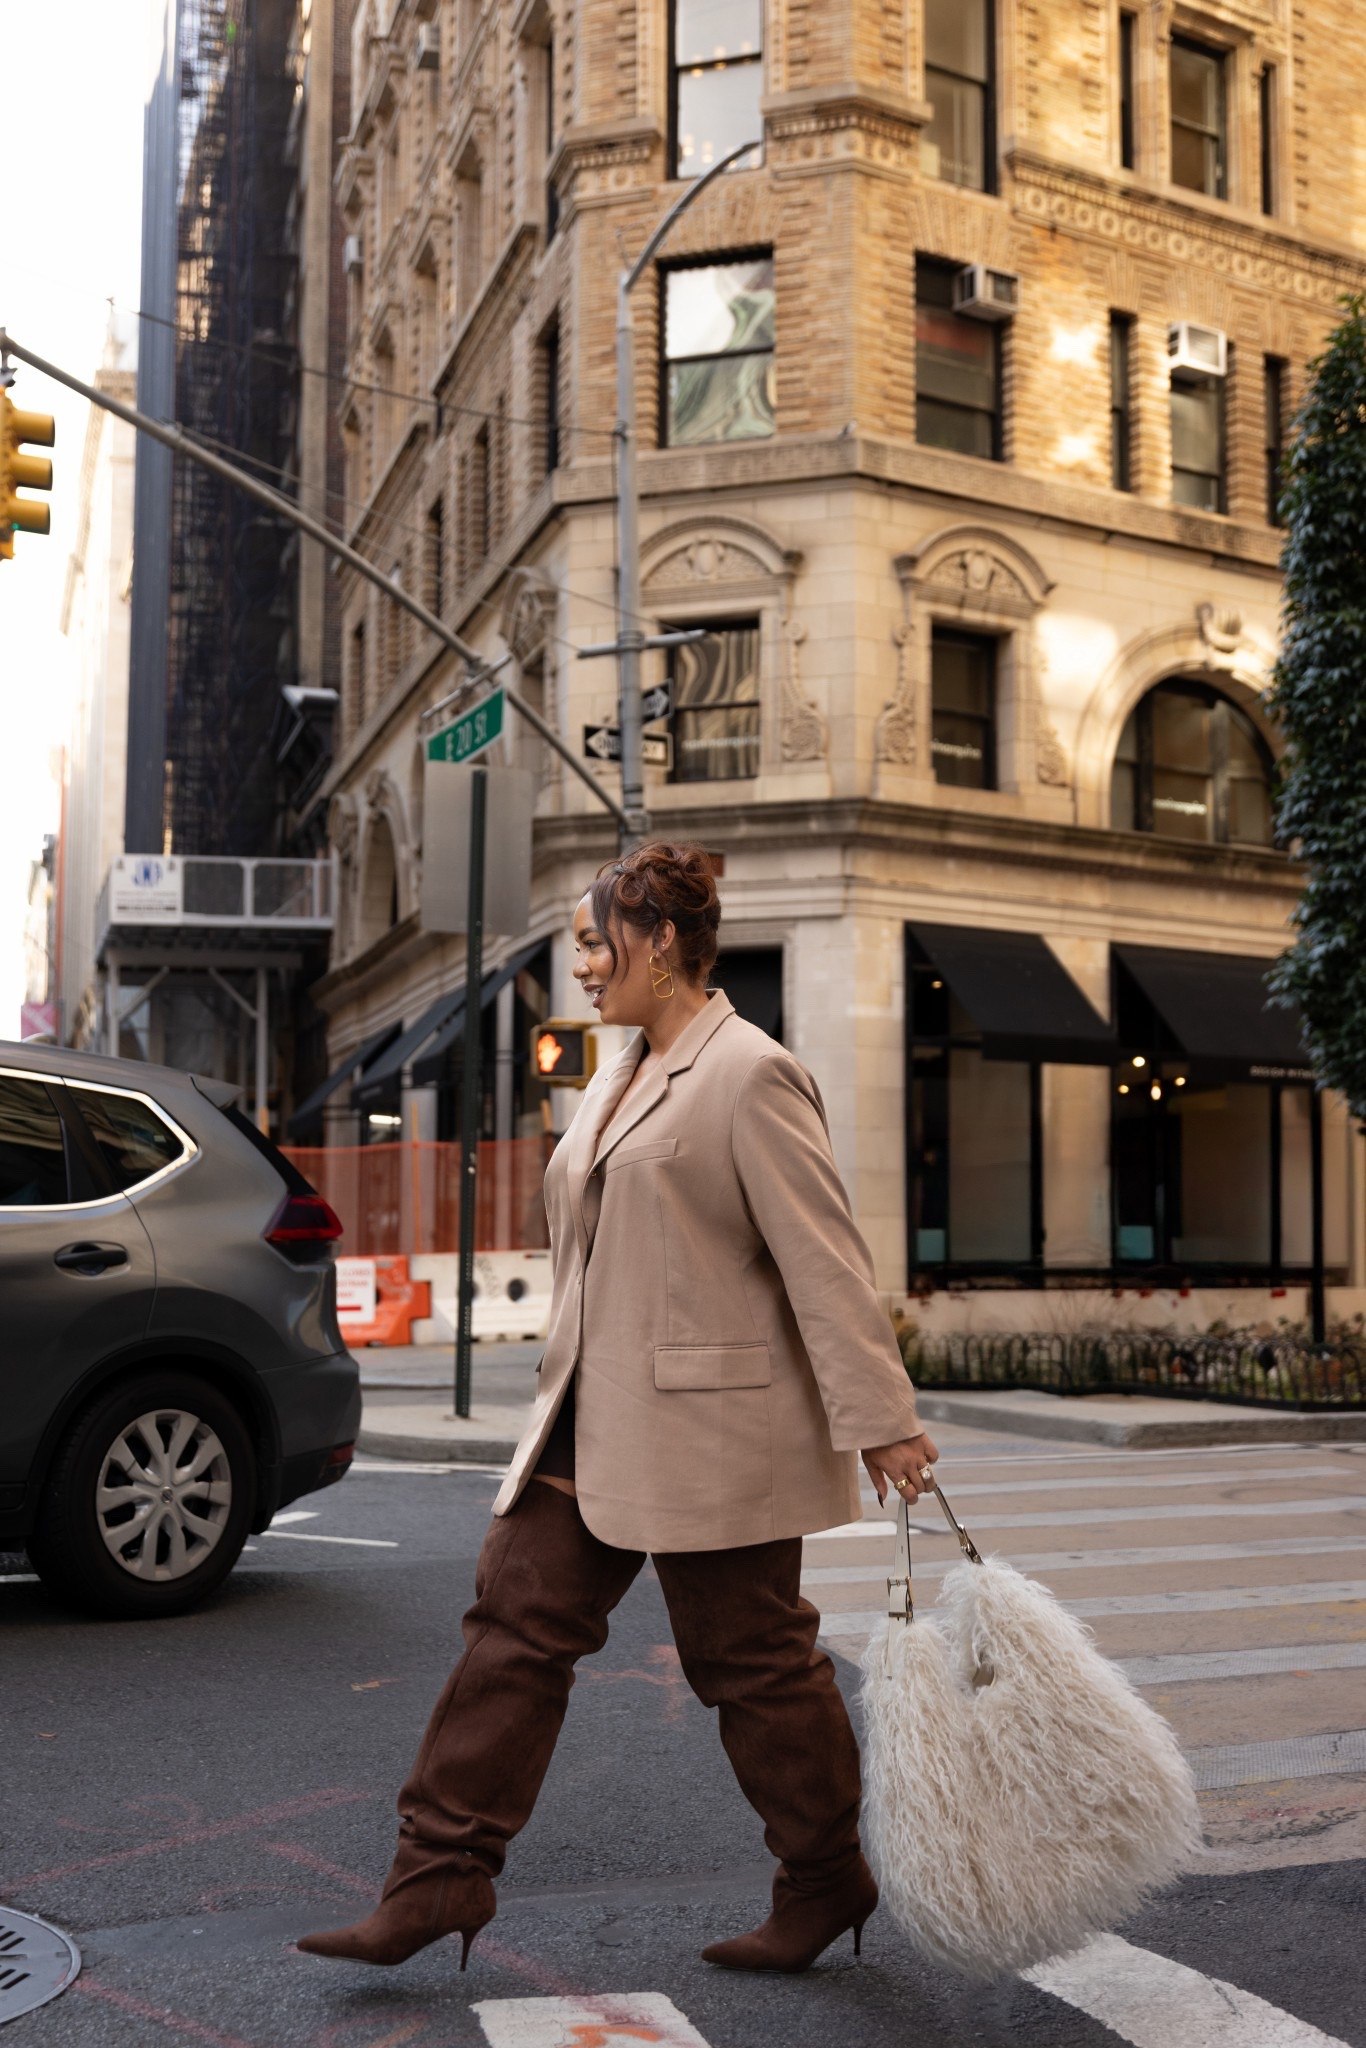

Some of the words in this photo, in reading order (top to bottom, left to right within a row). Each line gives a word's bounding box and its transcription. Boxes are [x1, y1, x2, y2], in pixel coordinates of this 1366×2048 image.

[445, 732, 454, 763] E
[456, 721, 473, 756] 20
[474, 709, 487, 744] St
